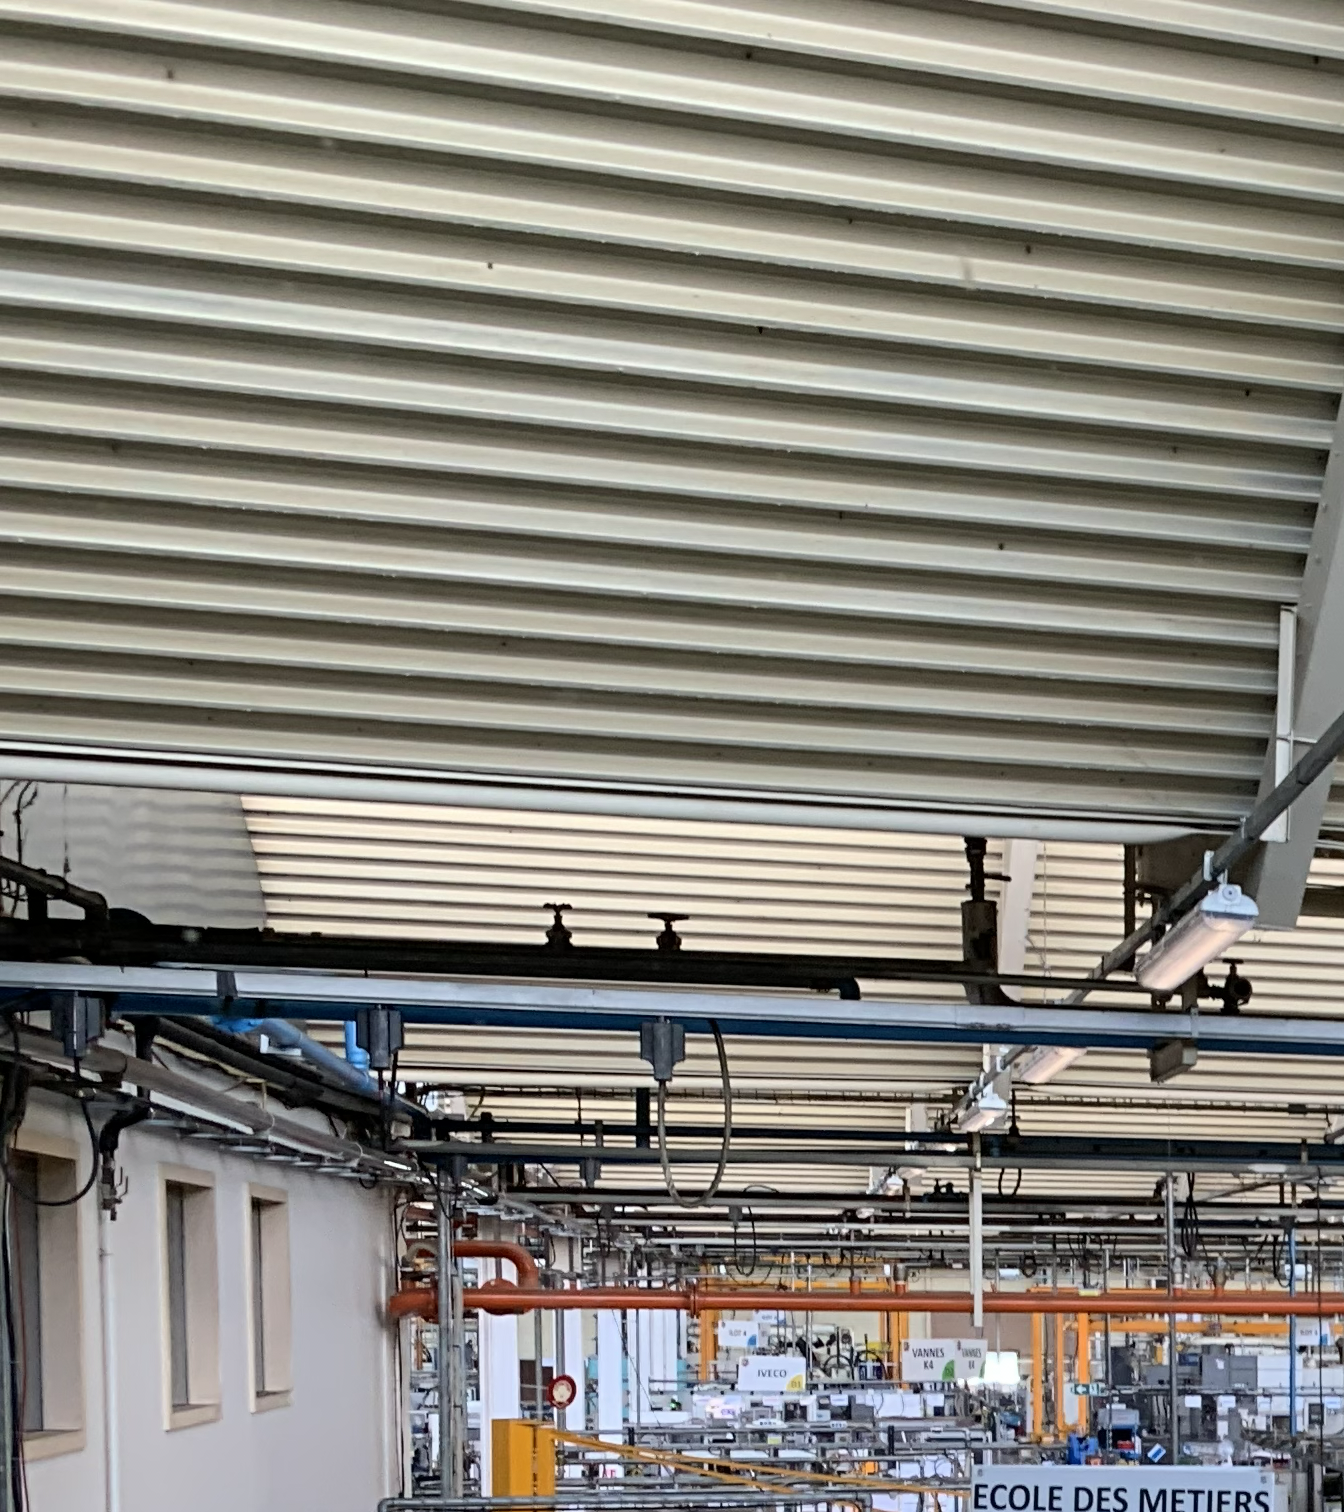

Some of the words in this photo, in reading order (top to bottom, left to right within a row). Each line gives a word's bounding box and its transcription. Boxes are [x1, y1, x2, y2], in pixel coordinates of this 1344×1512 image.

[912, 1347, 945, 1358] VANNES
[923, 1360, 934, 1370] K4
[757, 1369, 788, 1378] IVECO
[973, 1483, 1063, 1512] ECOLE
